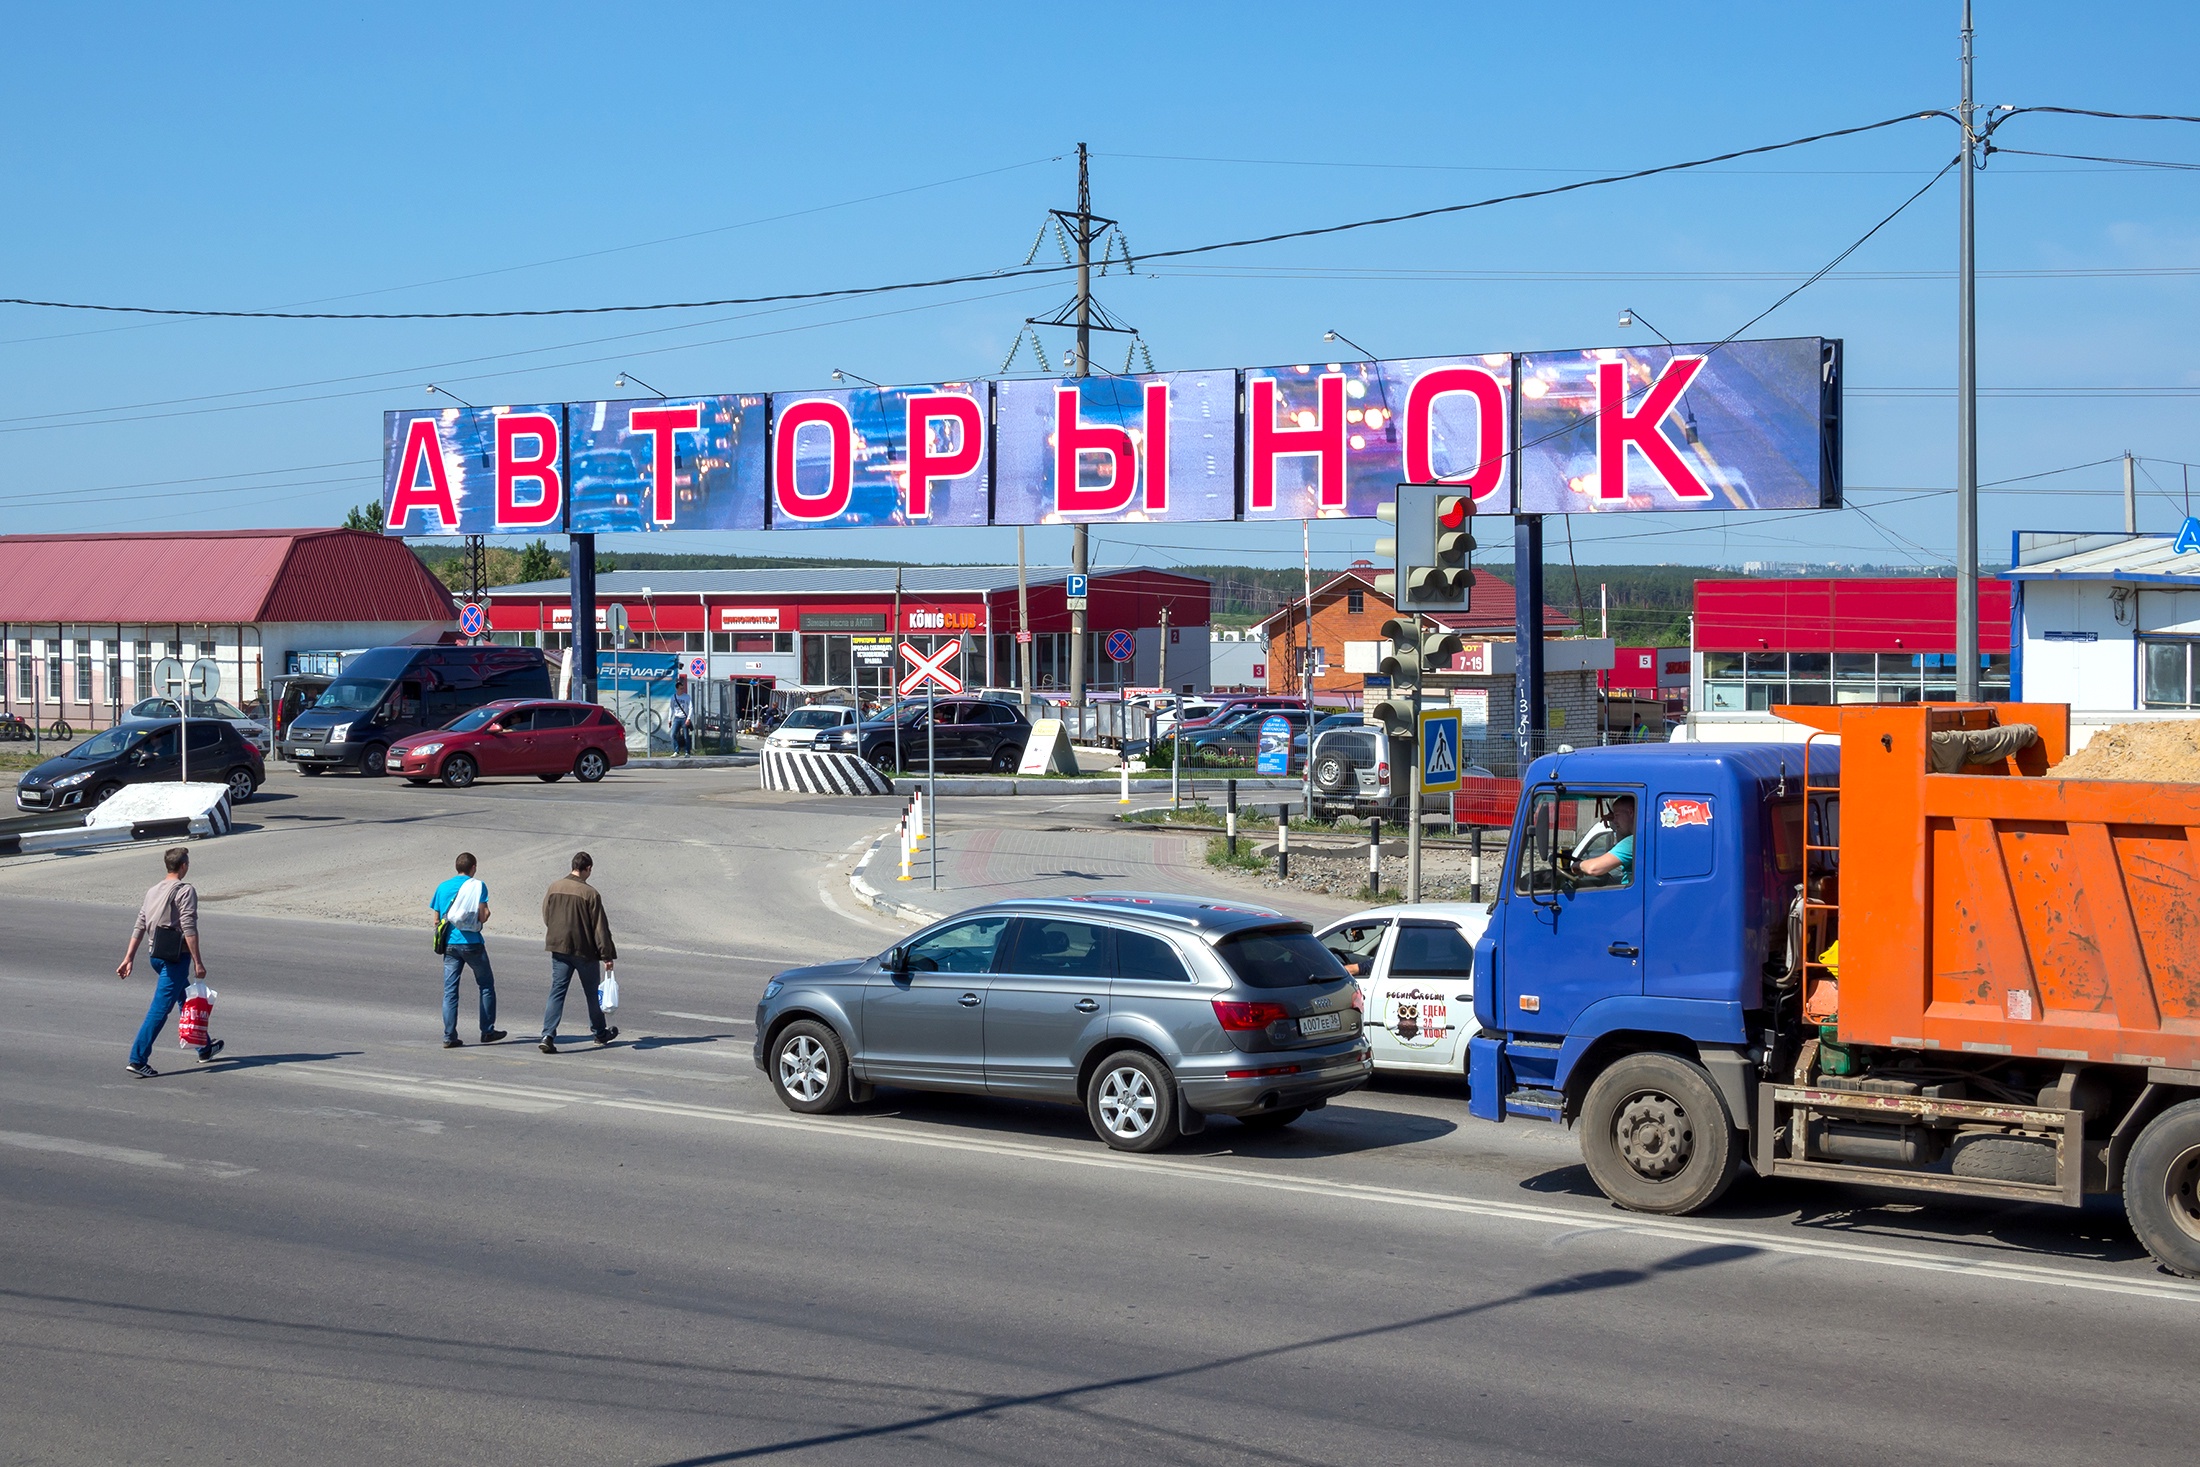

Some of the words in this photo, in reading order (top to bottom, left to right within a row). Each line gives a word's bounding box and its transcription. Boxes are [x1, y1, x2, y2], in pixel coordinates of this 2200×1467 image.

[385, 353, 1714, 529] АВТОРЫНОК
[600, 667, 675, 677] FORWARD
[1423, 1005, 1446, 1018] ЕДЕМ
[1423, 1018, 1433, 1028] ЗА
